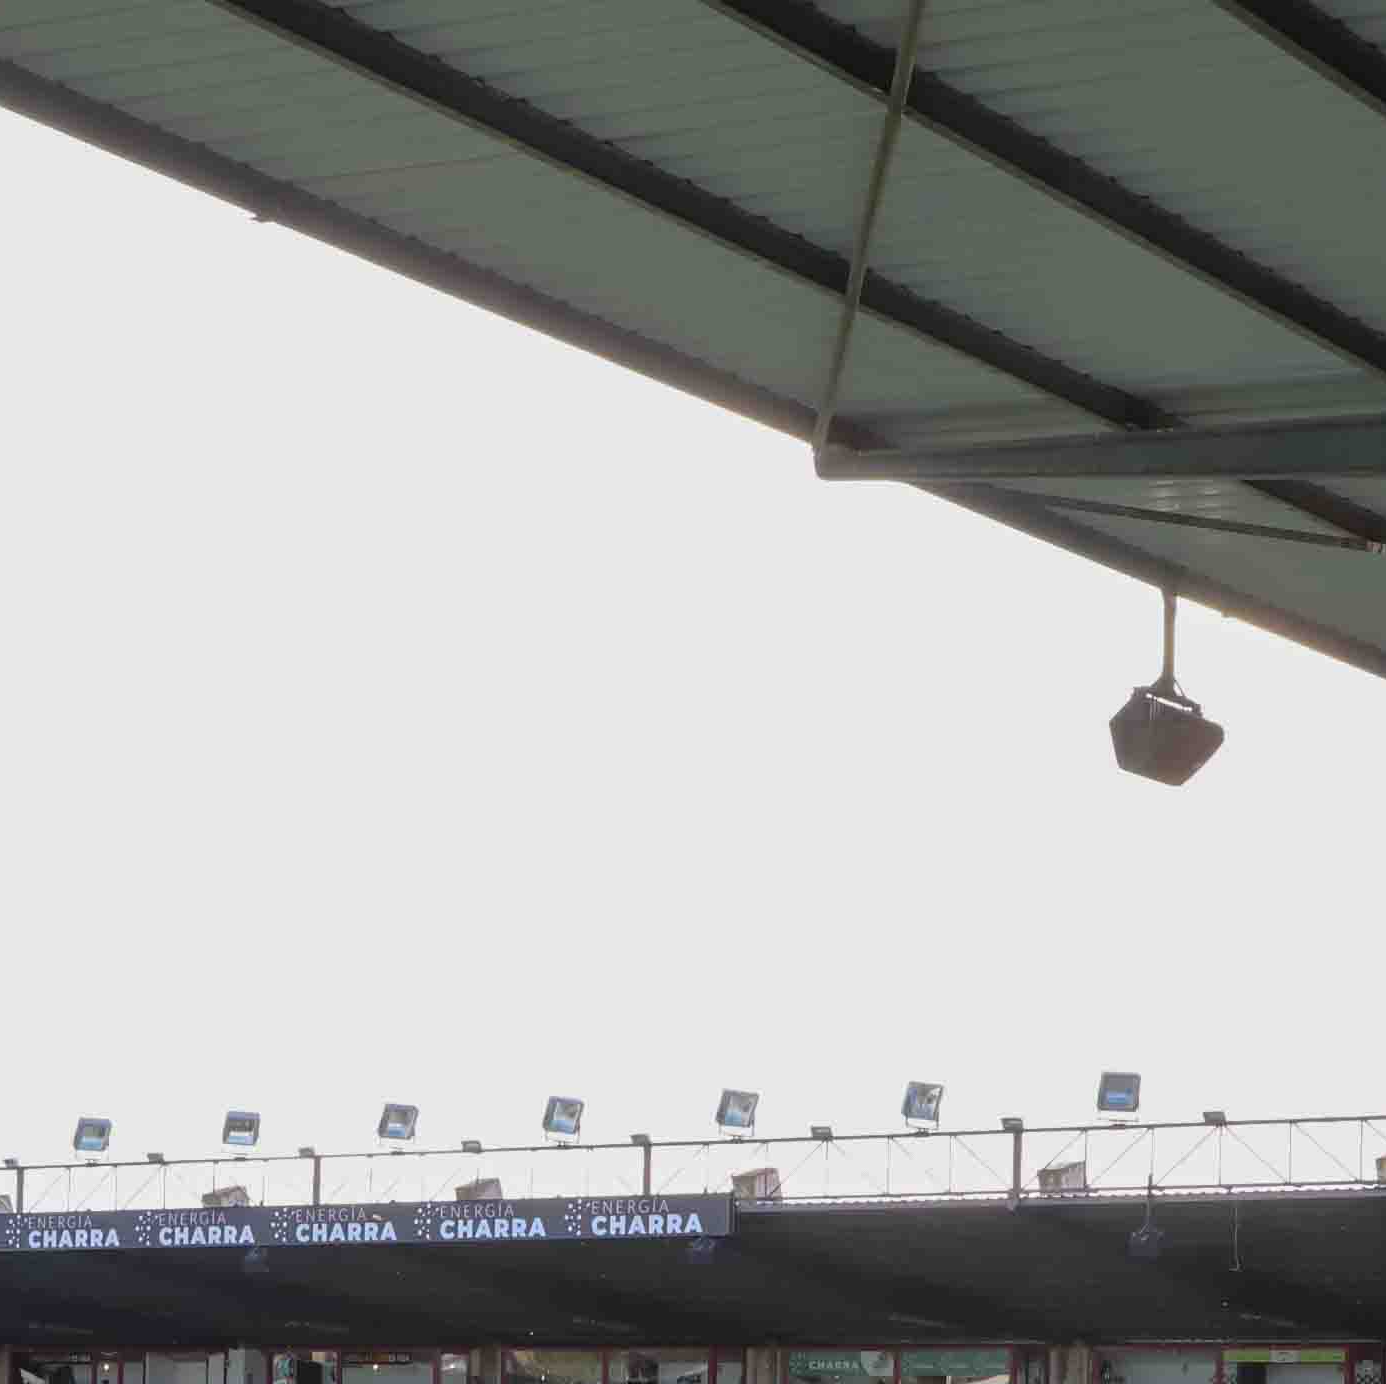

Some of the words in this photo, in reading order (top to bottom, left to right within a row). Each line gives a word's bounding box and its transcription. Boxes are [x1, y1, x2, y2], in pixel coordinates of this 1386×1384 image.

[295, 1222, 397, 1242] CHARRA
[439, 1217, 546, 1239] CHARRA
[591, 1213, 703, 1236] CHARRA
[28, 1229, 120, 1248] CHARRA
[159, 1225, 255, 1246] CHARRA
